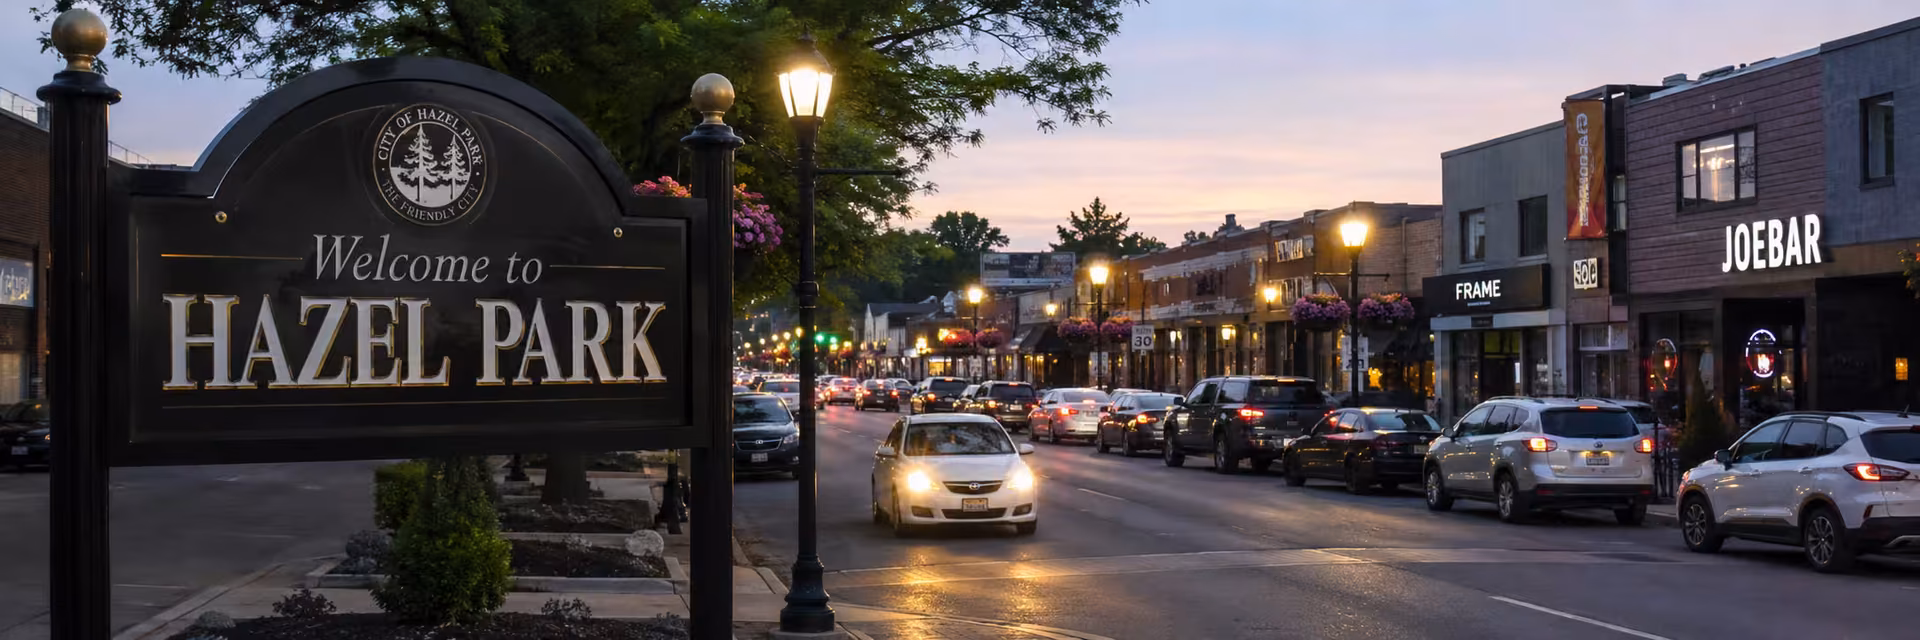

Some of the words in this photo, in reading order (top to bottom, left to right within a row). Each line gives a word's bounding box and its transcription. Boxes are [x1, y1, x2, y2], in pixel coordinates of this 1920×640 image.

[378, 126, 397, 161] CITY
[396, 111, 413, 129] OF
[417, 108, 461, 130] HAZEL
[461, 127, 483, 166] PARK
[382, 179, 400, 205] THE
[400, 201, 456, 221] FRIENDLY
[458, 183, 479, 210] CITY
[313, 233, 490, 283] Welcome
[506, 251, 543, 284] to
[1722, 213, 1822, 273] JOEBAR
[1456, 279, 1501, 300] FRAME
[162, 293, 451, 390] HAZEL
[475, 297, 667, 386] PARK
[1134, 336, 1152, 347] 30
